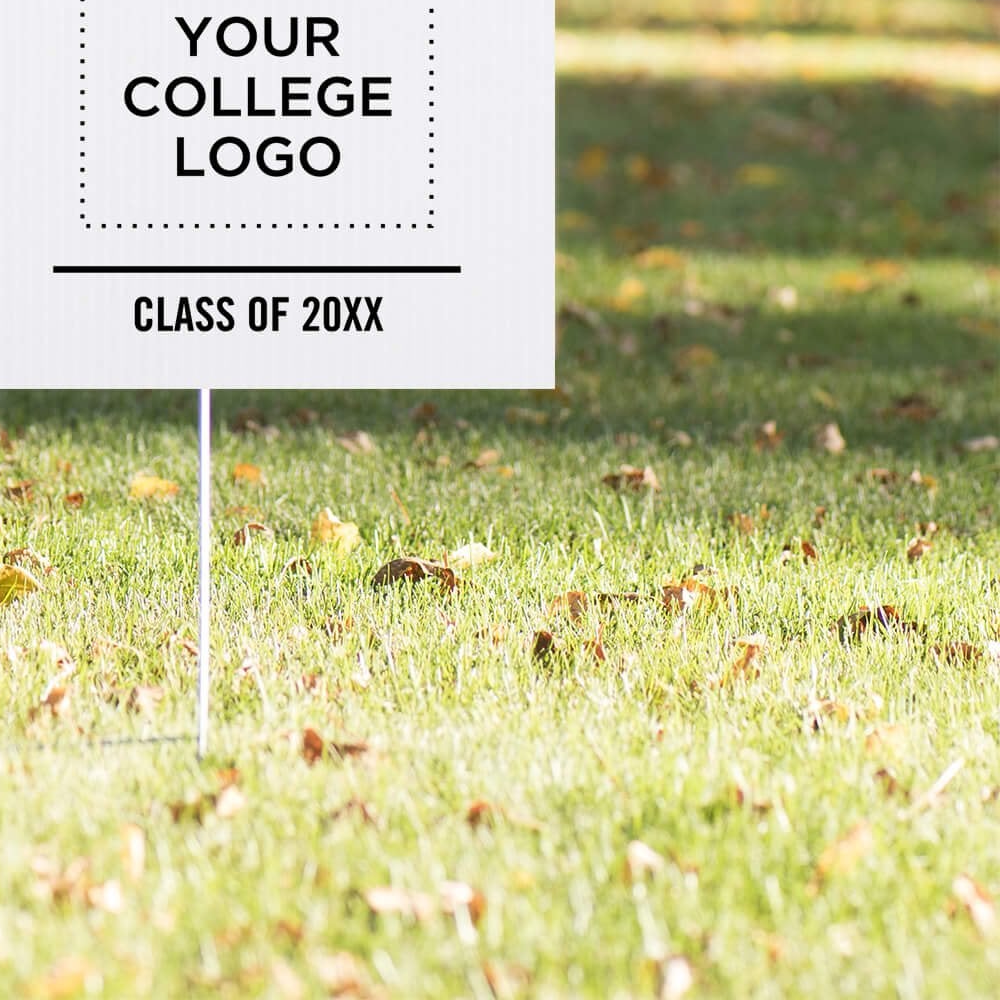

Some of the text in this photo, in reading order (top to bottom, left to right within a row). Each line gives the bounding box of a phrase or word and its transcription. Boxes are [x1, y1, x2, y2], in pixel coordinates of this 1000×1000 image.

[174, 16, 340, 58] YOUR
[123, 76, 393, 118] COLLEGE
[176, 136, 341, 178] LOGO
[134, 296, 384, 333] CLASS OF 20XX
